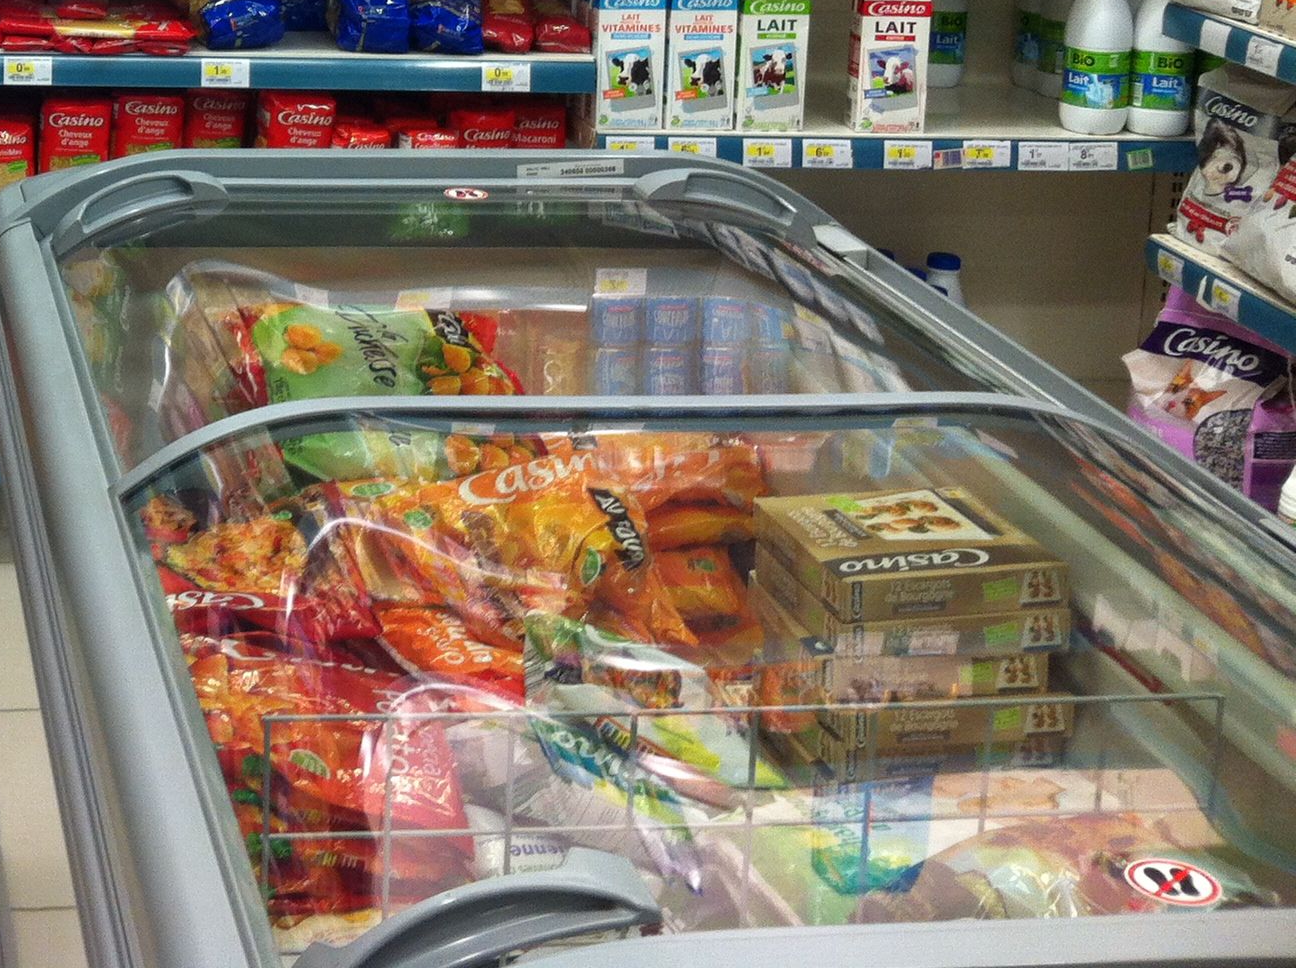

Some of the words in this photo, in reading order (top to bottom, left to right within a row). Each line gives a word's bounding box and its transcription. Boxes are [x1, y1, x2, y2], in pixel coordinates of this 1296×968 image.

[750, 0, 805, 14] Casino
[867, 1, 926, 16] Casino
[621, 14, 640, 22] LAIT
[694, 14, 713, 22] LAIT
[757, 19, 798, 32] LAIT
[875, 21, 917, 34] LAIT
[1072, 54, 1095, 67] BiO
[1158, 56, 1184, 69] BiO
[1068, 73, 1090, 85] Lait
[1153, 76, 1179, 88] Lait
[125, 100, 177, 115] Casino
[193, 96, 246, 110] Casino
[278, 110, 332, 125] Casino
[1205, 96, 1258, 128] Casino
[49, 113, 103, 128] Casino
[518, 117, 559, 129] asino
[464, 129, 511, 141] Casino
[512, 133, 556, 144] Macaroni
[1164, 328, 1260, 371] Casino
[459, 452, 597, 505] Casin
[839, 548, 989, 573] Casino
